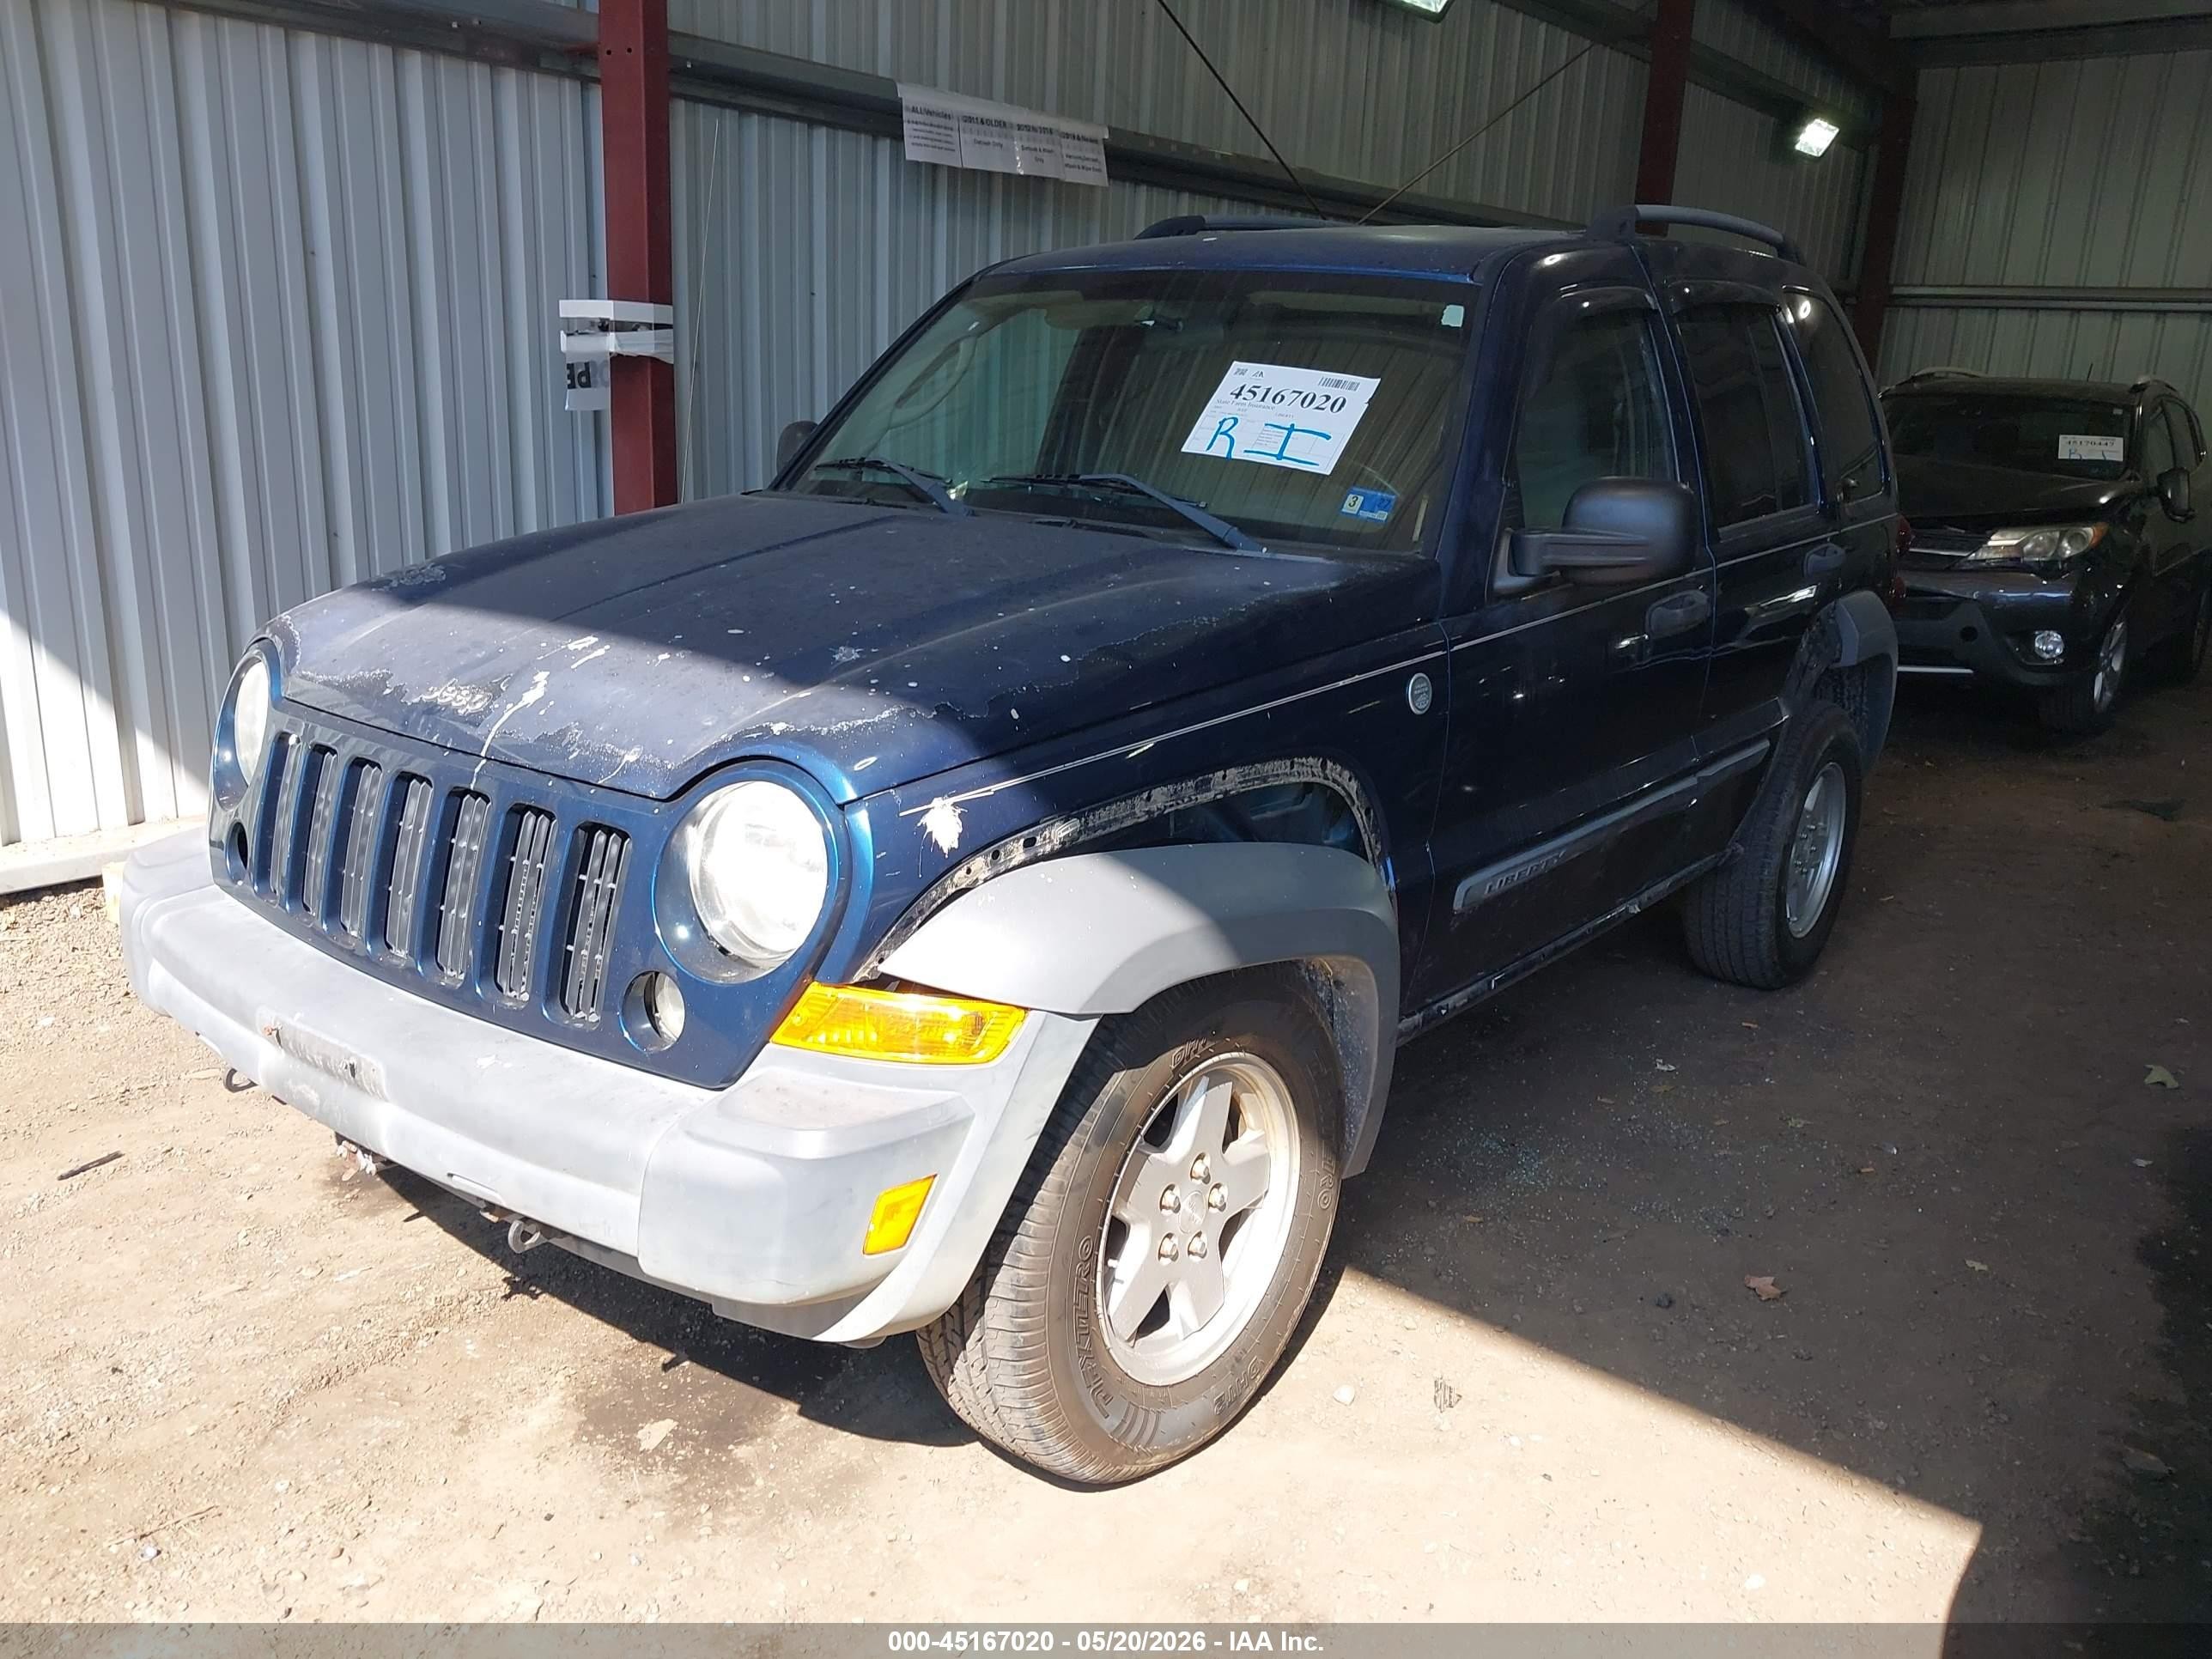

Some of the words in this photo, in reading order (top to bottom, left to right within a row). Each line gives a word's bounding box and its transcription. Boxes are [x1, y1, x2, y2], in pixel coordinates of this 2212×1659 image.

[1230, 383, 1347, 413] 45167020
[1206, 416, 1239, 460] R
[1349, 495, 1358, 507] 3
[1484, 848, 1566, 895] LIBERTY
